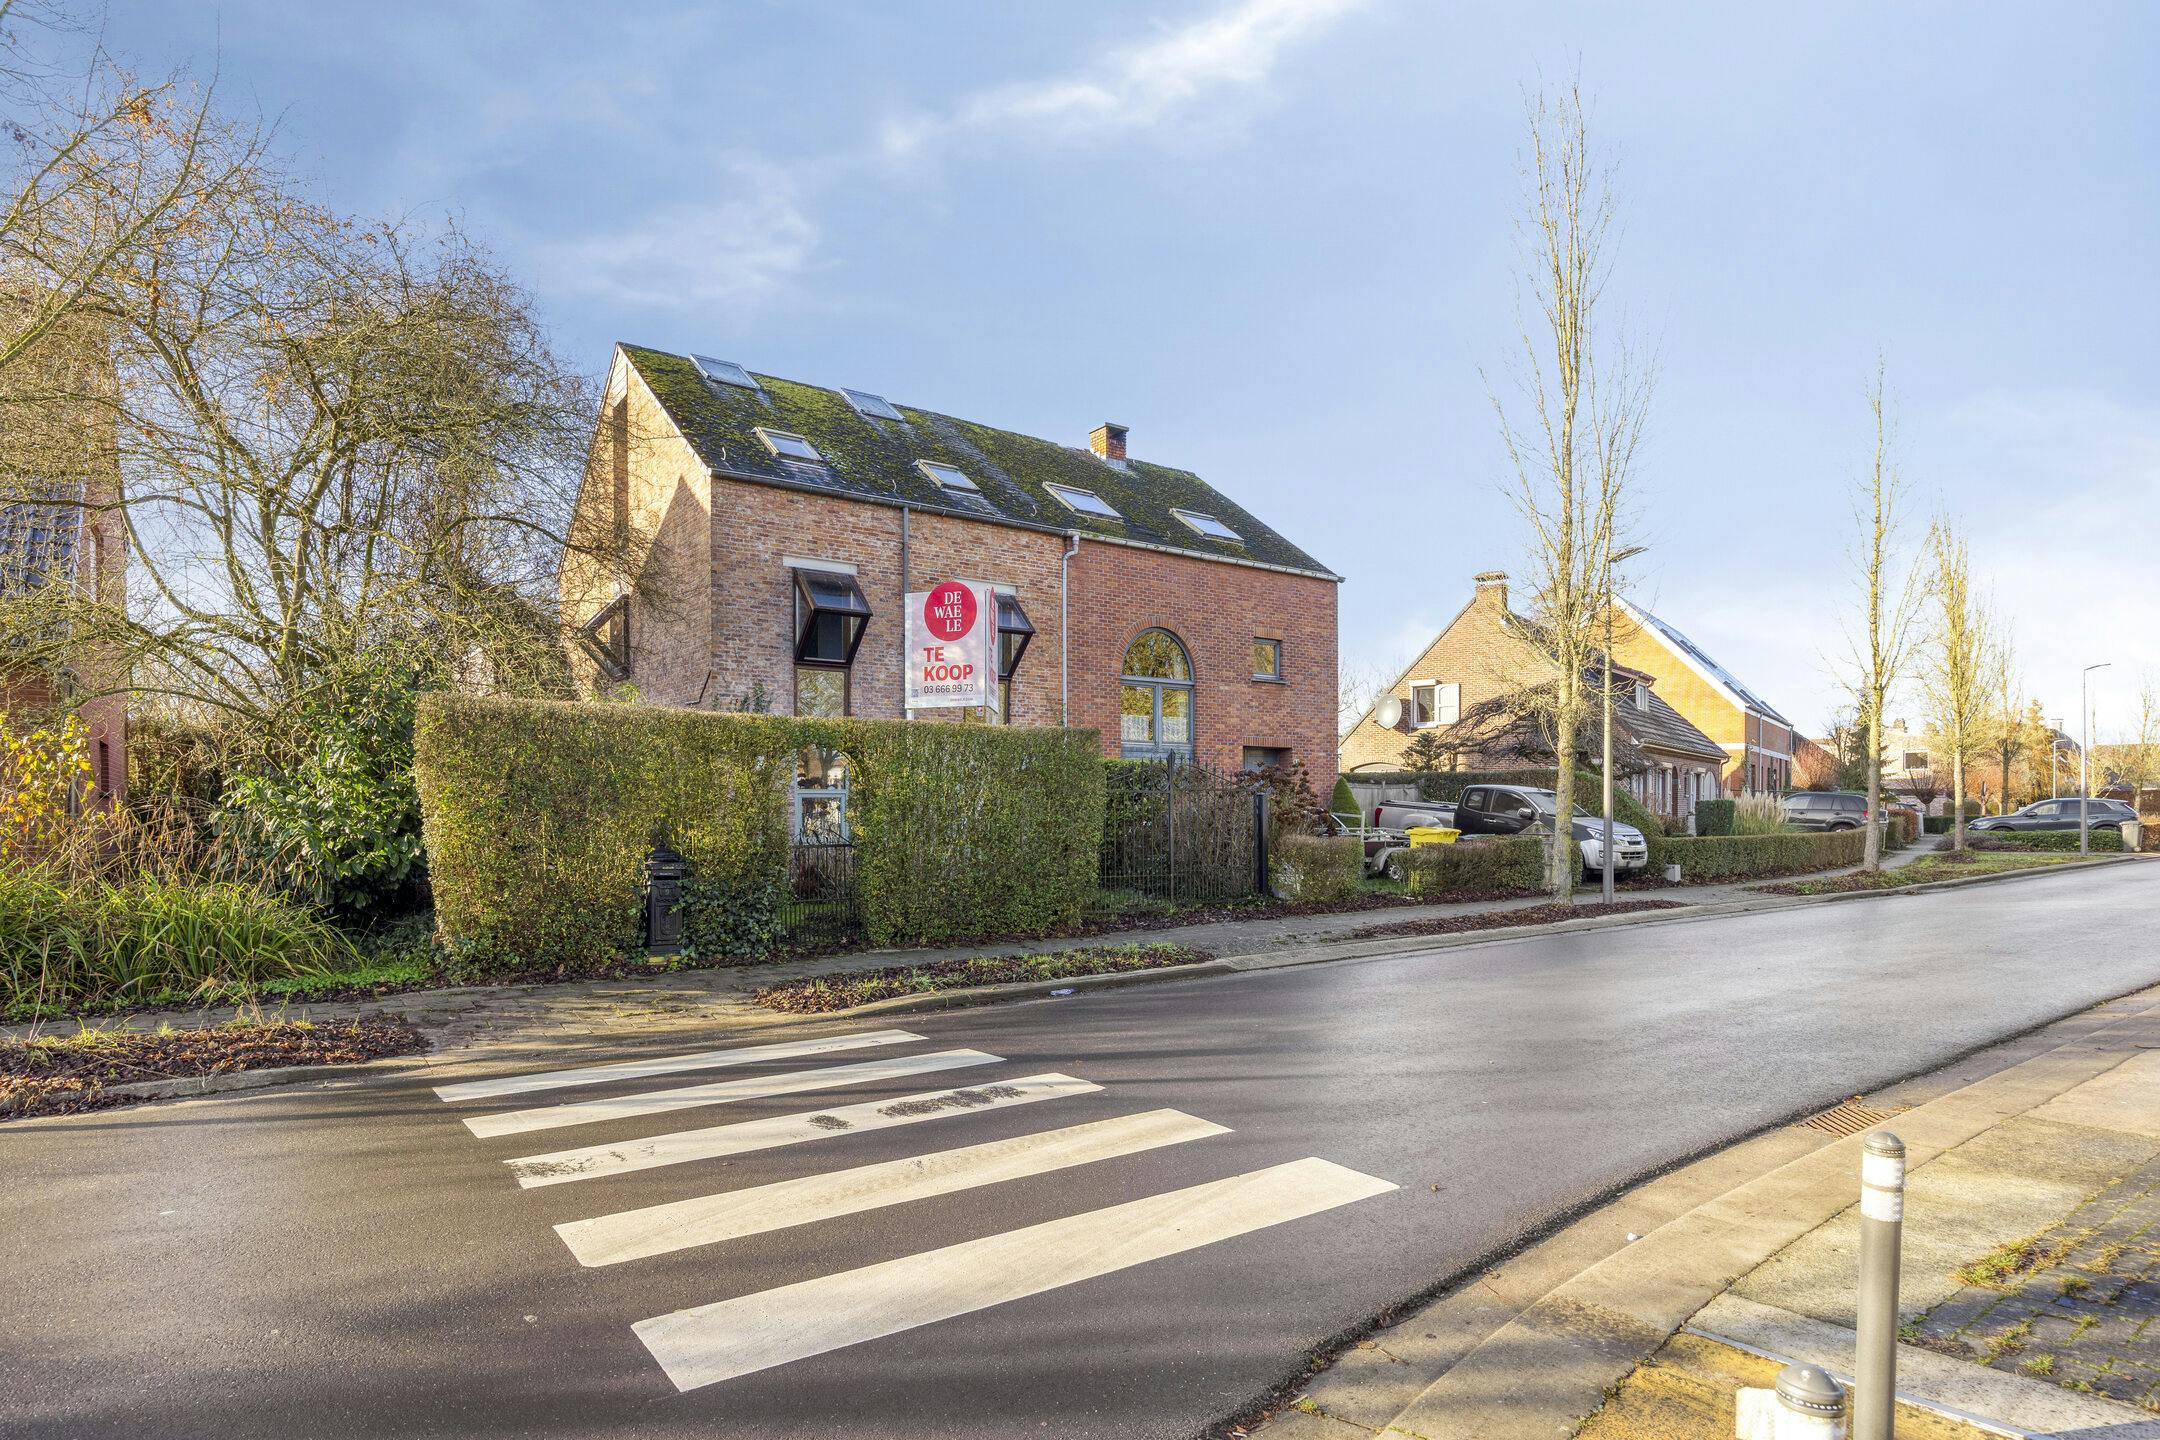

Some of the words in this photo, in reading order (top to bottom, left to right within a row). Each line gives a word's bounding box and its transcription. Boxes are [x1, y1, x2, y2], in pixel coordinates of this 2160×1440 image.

[944, 591, 962, 605] DE
[934, 605, 962, 619] WAE
[946, 619, 962, 632] LE
[923, 647, 944, 662] TE
[924, 664, 974, 682] KOOP
[923, 685, 934, 694] 03
[935, 684, 950, 693] 666
[951, 683, 962, 693] 99
[963, 683, 974, 692] 73
